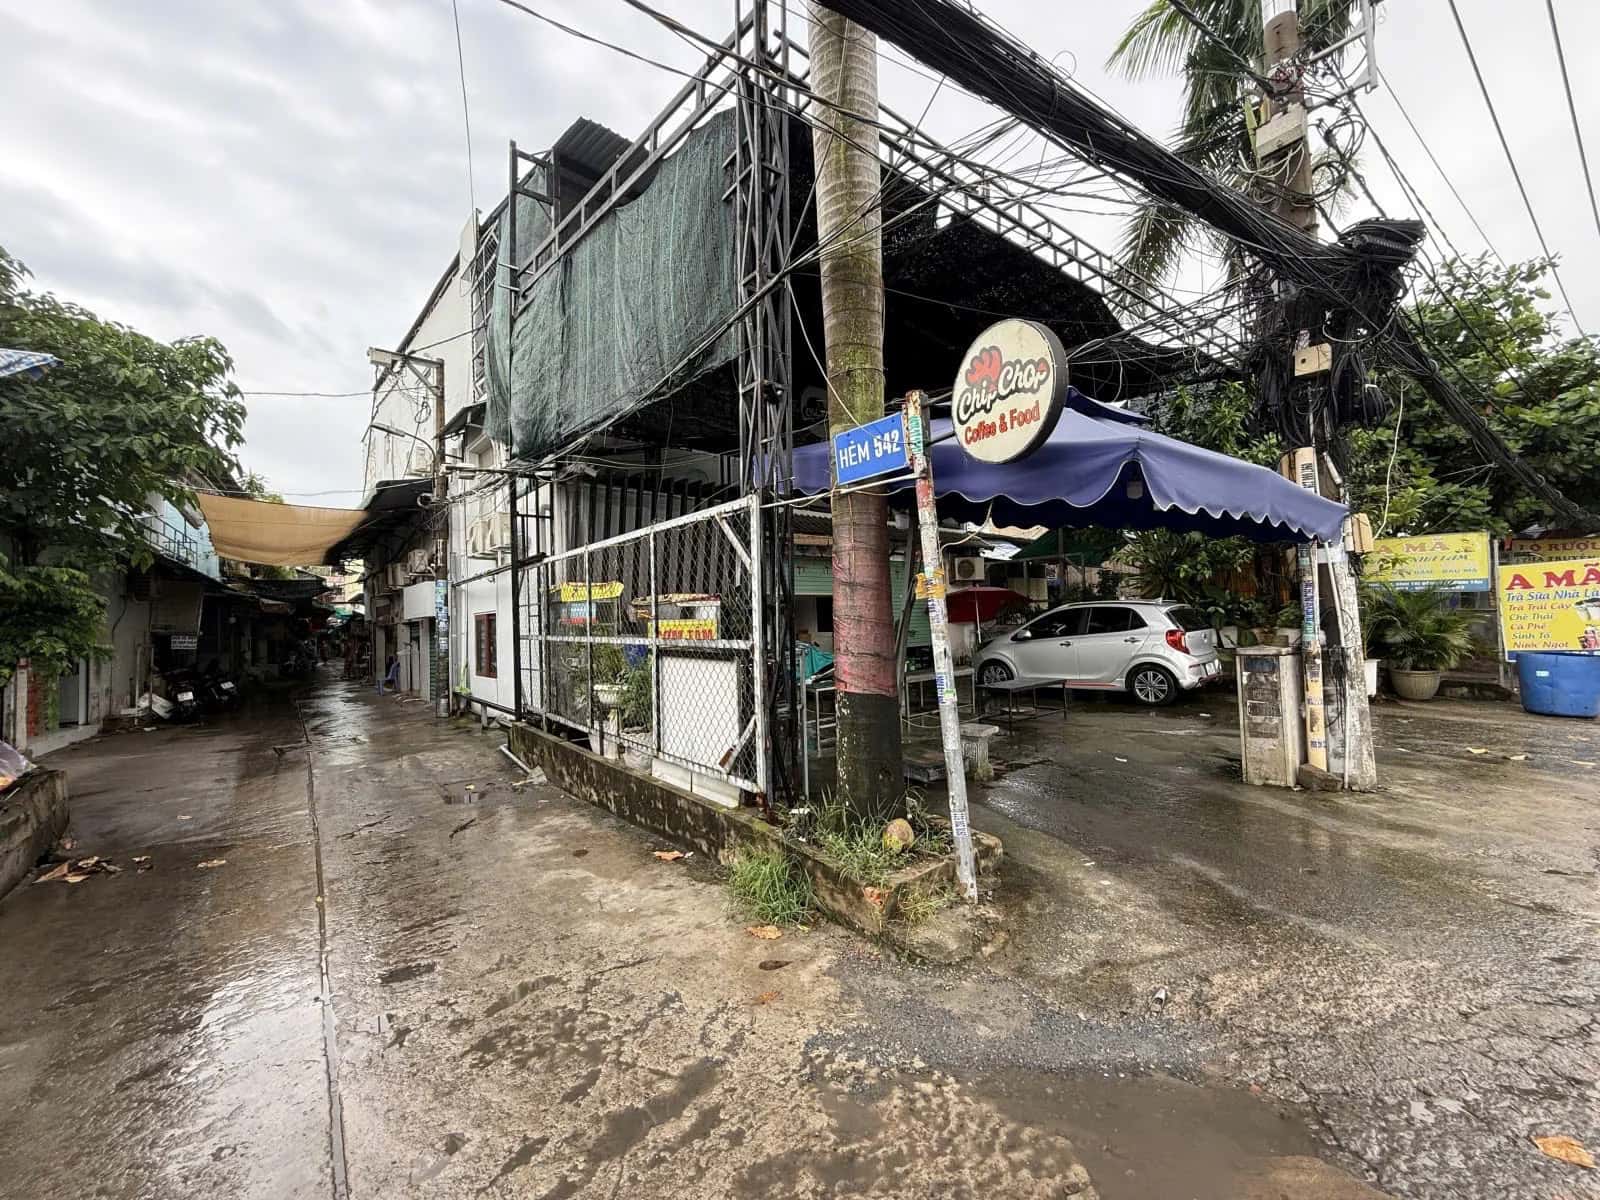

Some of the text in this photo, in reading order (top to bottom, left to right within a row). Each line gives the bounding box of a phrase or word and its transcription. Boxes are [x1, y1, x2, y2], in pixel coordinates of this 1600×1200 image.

[965, 400, 1041, 445] Coffee & Food
[873, 429, 901, 459] 542
[1505, 573, 1535, 590] A
